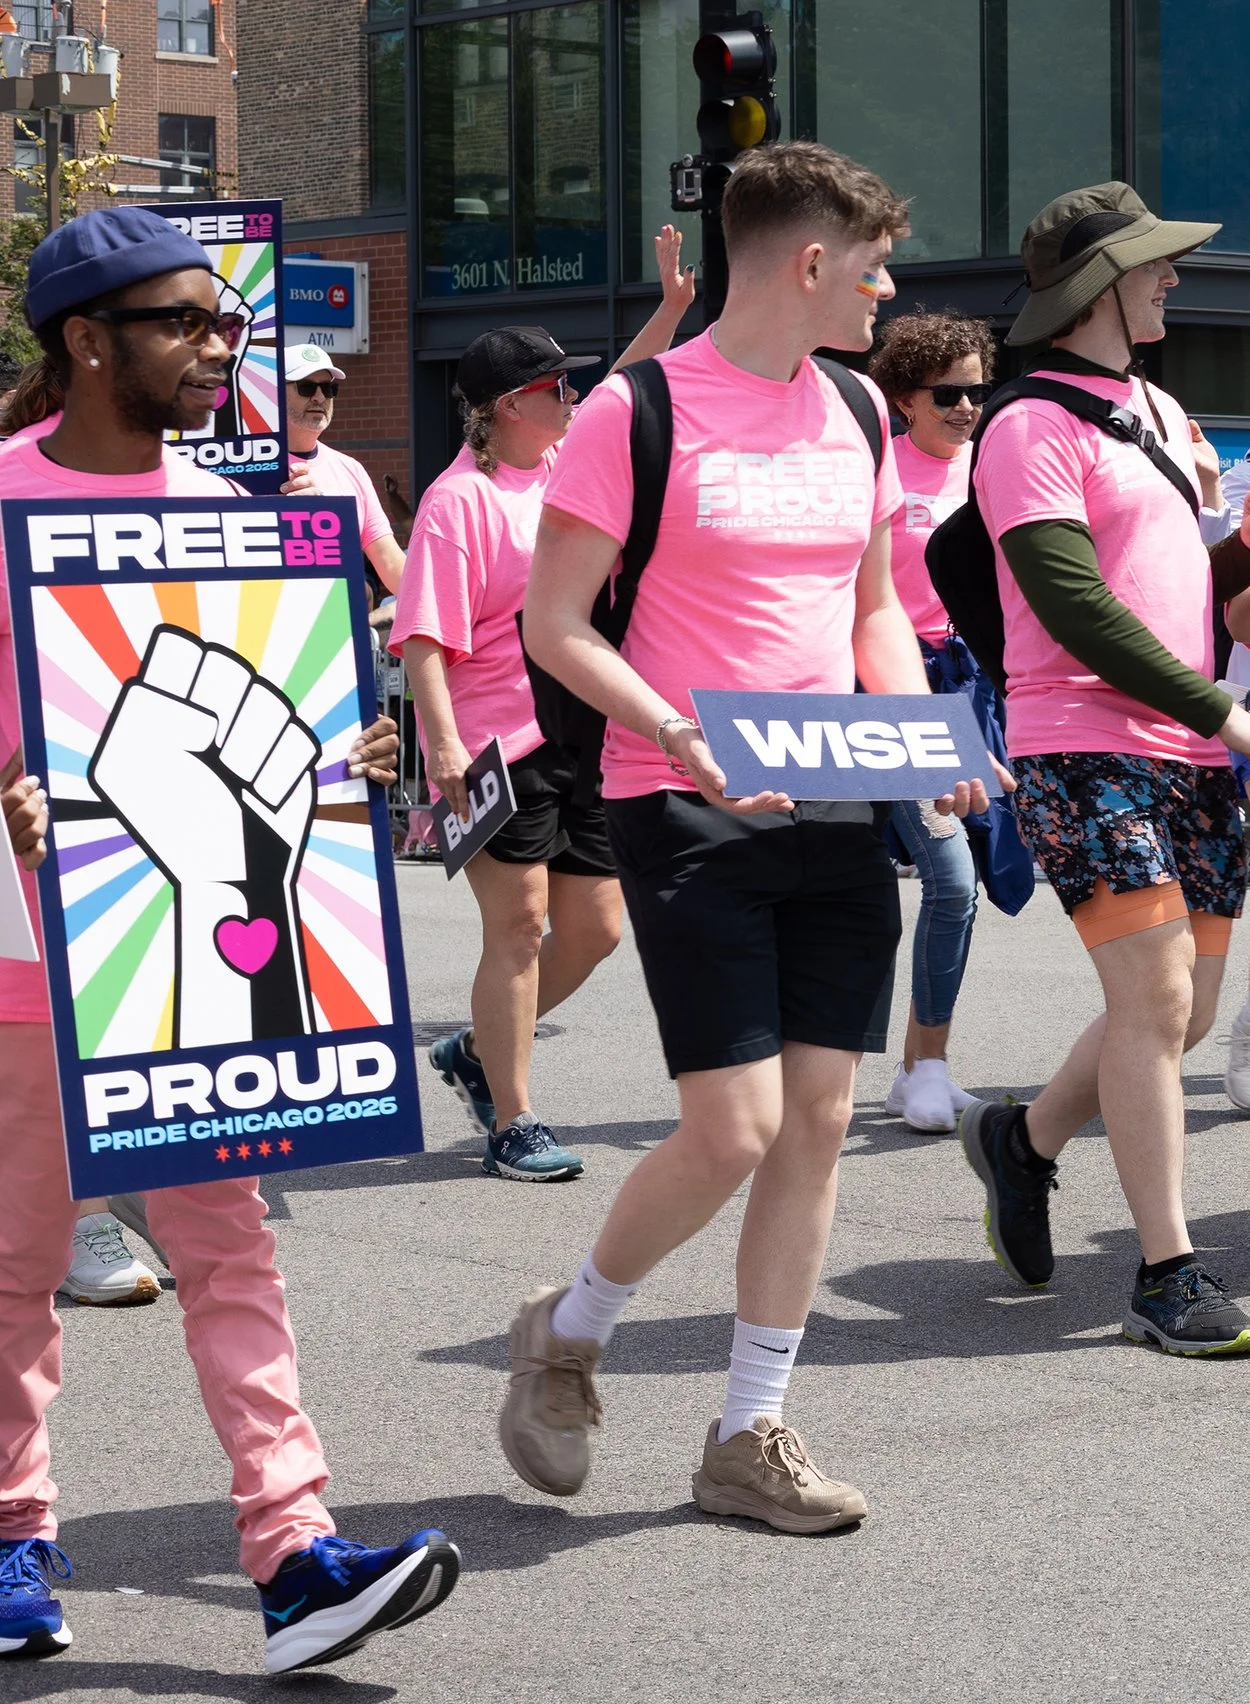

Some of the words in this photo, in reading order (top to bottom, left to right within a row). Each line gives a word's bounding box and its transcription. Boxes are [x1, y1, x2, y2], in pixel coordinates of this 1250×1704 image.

[165, 214, 244, 240] REE
[245, 213, 273, 226] TO
[245, 225, 272, 238] BE
[452, 262, 489, 290] 3601
[516, 252, 584, 284] Halsted
[289, 288, 324, 301] BMO
[308, 332, 335, 347] ATM
[171, 439, 280, 466] ROUD
[245, 462, 280, 473] 2026
[698, 452, 834, 485] FREE
[697, 485, 870, 516] PROUD
[281, 510, 341, 538] TO
[696, 516, 759, 528] PRIDE
[760, 515, 837, 527] CHICAGO
[27, 511, 283, 573] FREE
[284, 539, 342, 567] BE
[732, 719, 962, 770] WISE
[443, 770, 500, 852] BOLD
[83, 1041, 397, 1128] PROUD
[89, 1123, 187, 1153] PRIDE
[189, 1105, 324, 1139] CHICAGO
[326, 1096, 398, 1123] 2026
